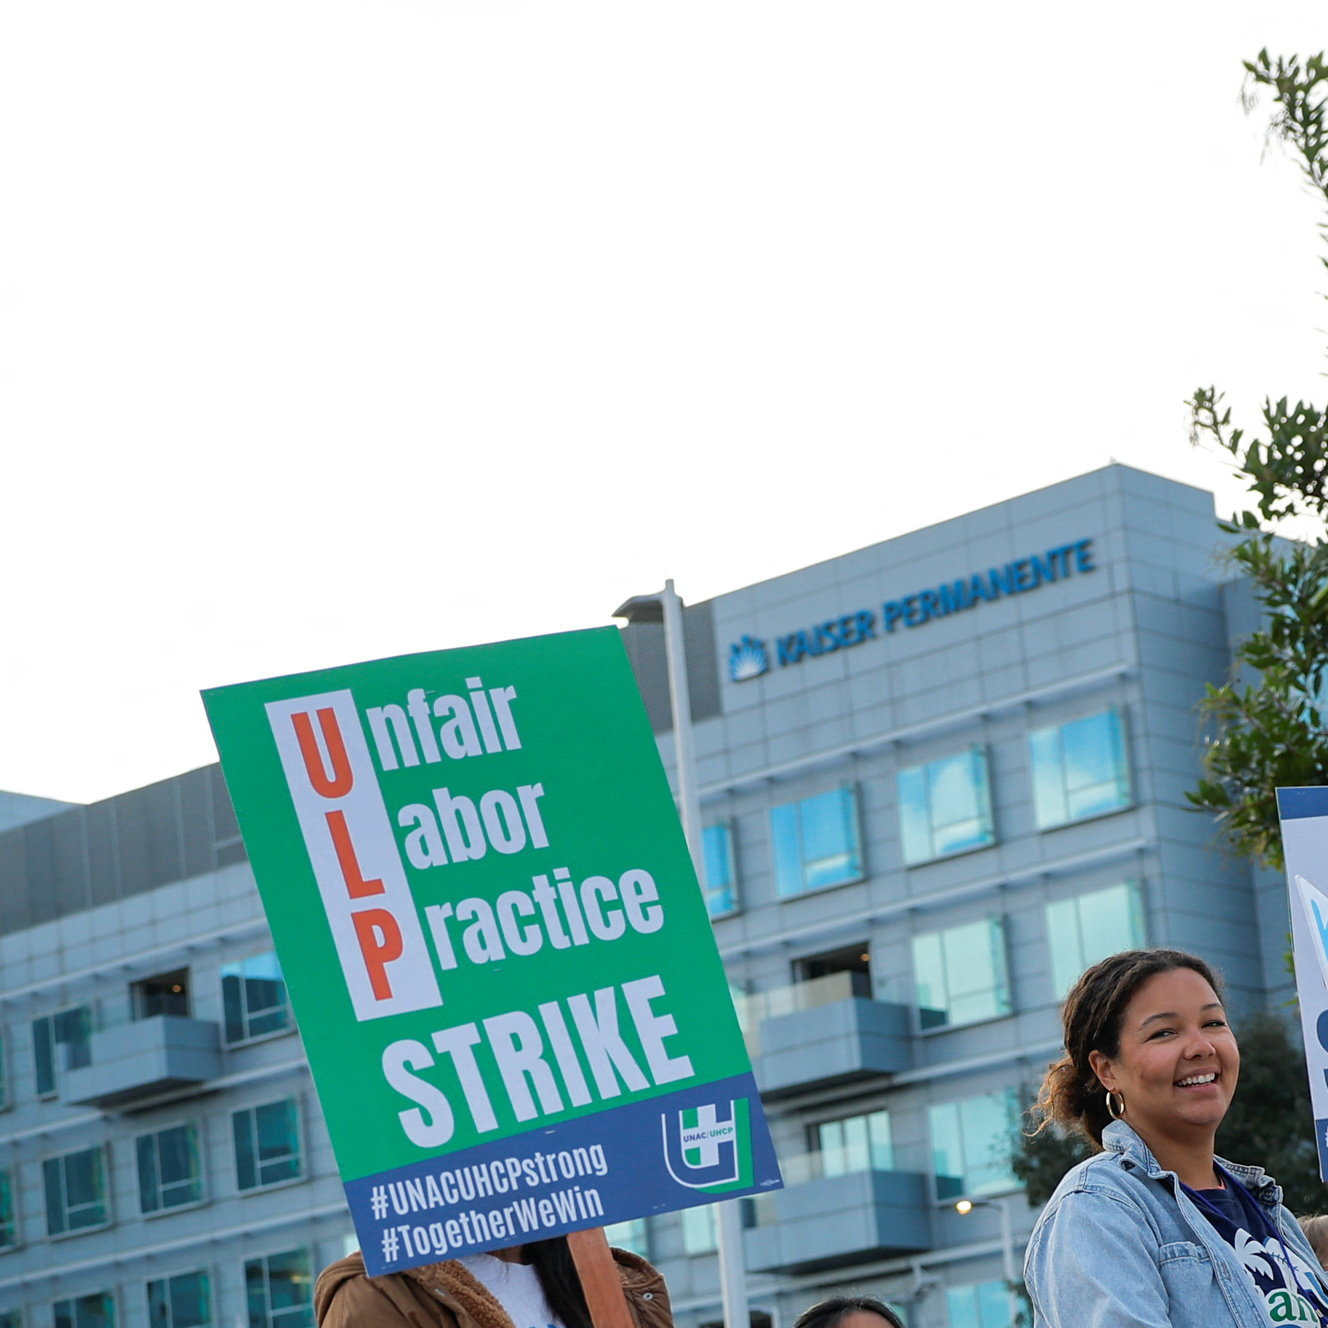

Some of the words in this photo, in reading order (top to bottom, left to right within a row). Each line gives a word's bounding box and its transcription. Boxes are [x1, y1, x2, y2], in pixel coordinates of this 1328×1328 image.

[777, 609, 877, 667] KAISER
[883, 537, 1097, 633] PERMANENTE
[382, 975, 696, 1148] STRIKE
[370, 1143, 609, 1220] #UNACUHCPstrong
[382, 1186, 604, 1262] #TogetherWeWin
